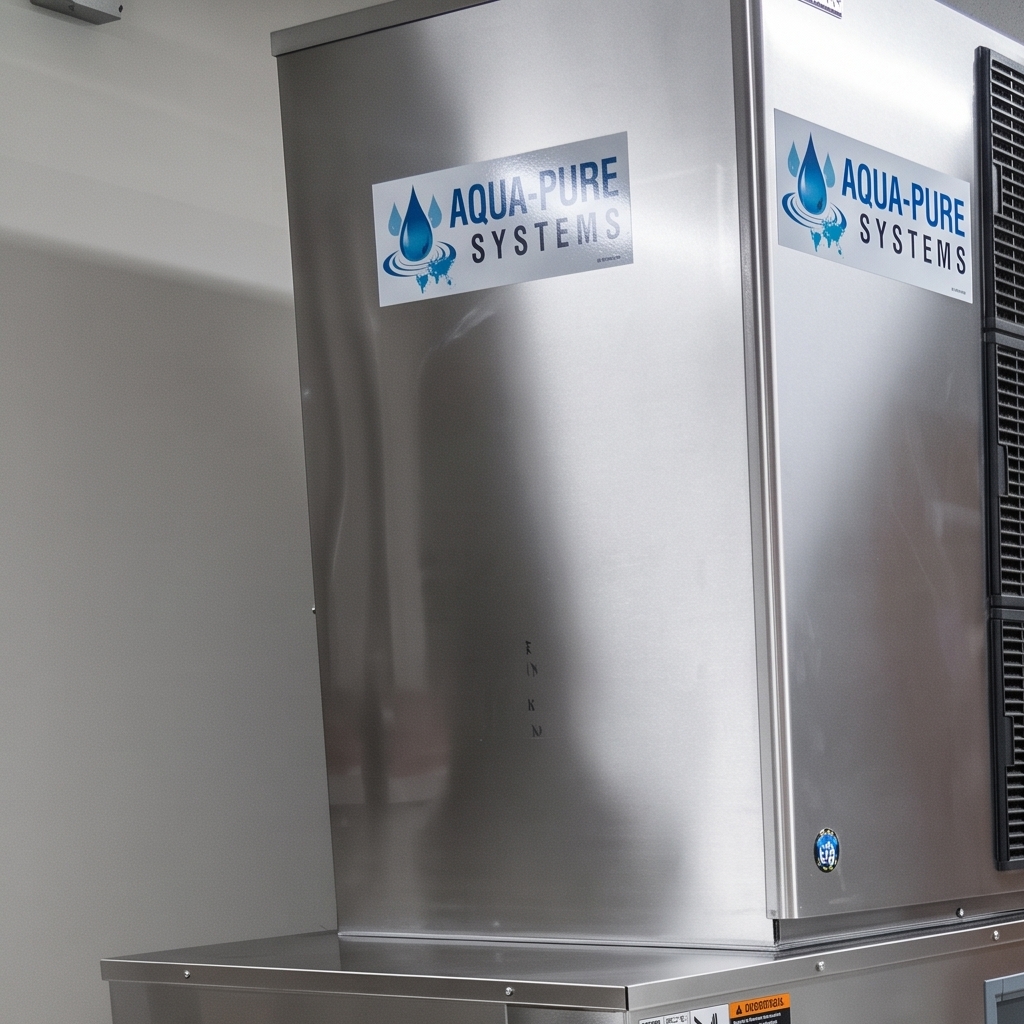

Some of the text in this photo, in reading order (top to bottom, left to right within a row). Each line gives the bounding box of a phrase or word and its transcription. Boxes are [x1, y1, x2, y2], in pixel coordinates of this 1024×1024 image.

[450, 156, 619, 229] AQUA-PURE
[842, 157, 966, 238] AQUA-PURE
[471, 208, 621, 264] SYSTEMS
[859, 213, 966, 275] SYSTEMS
